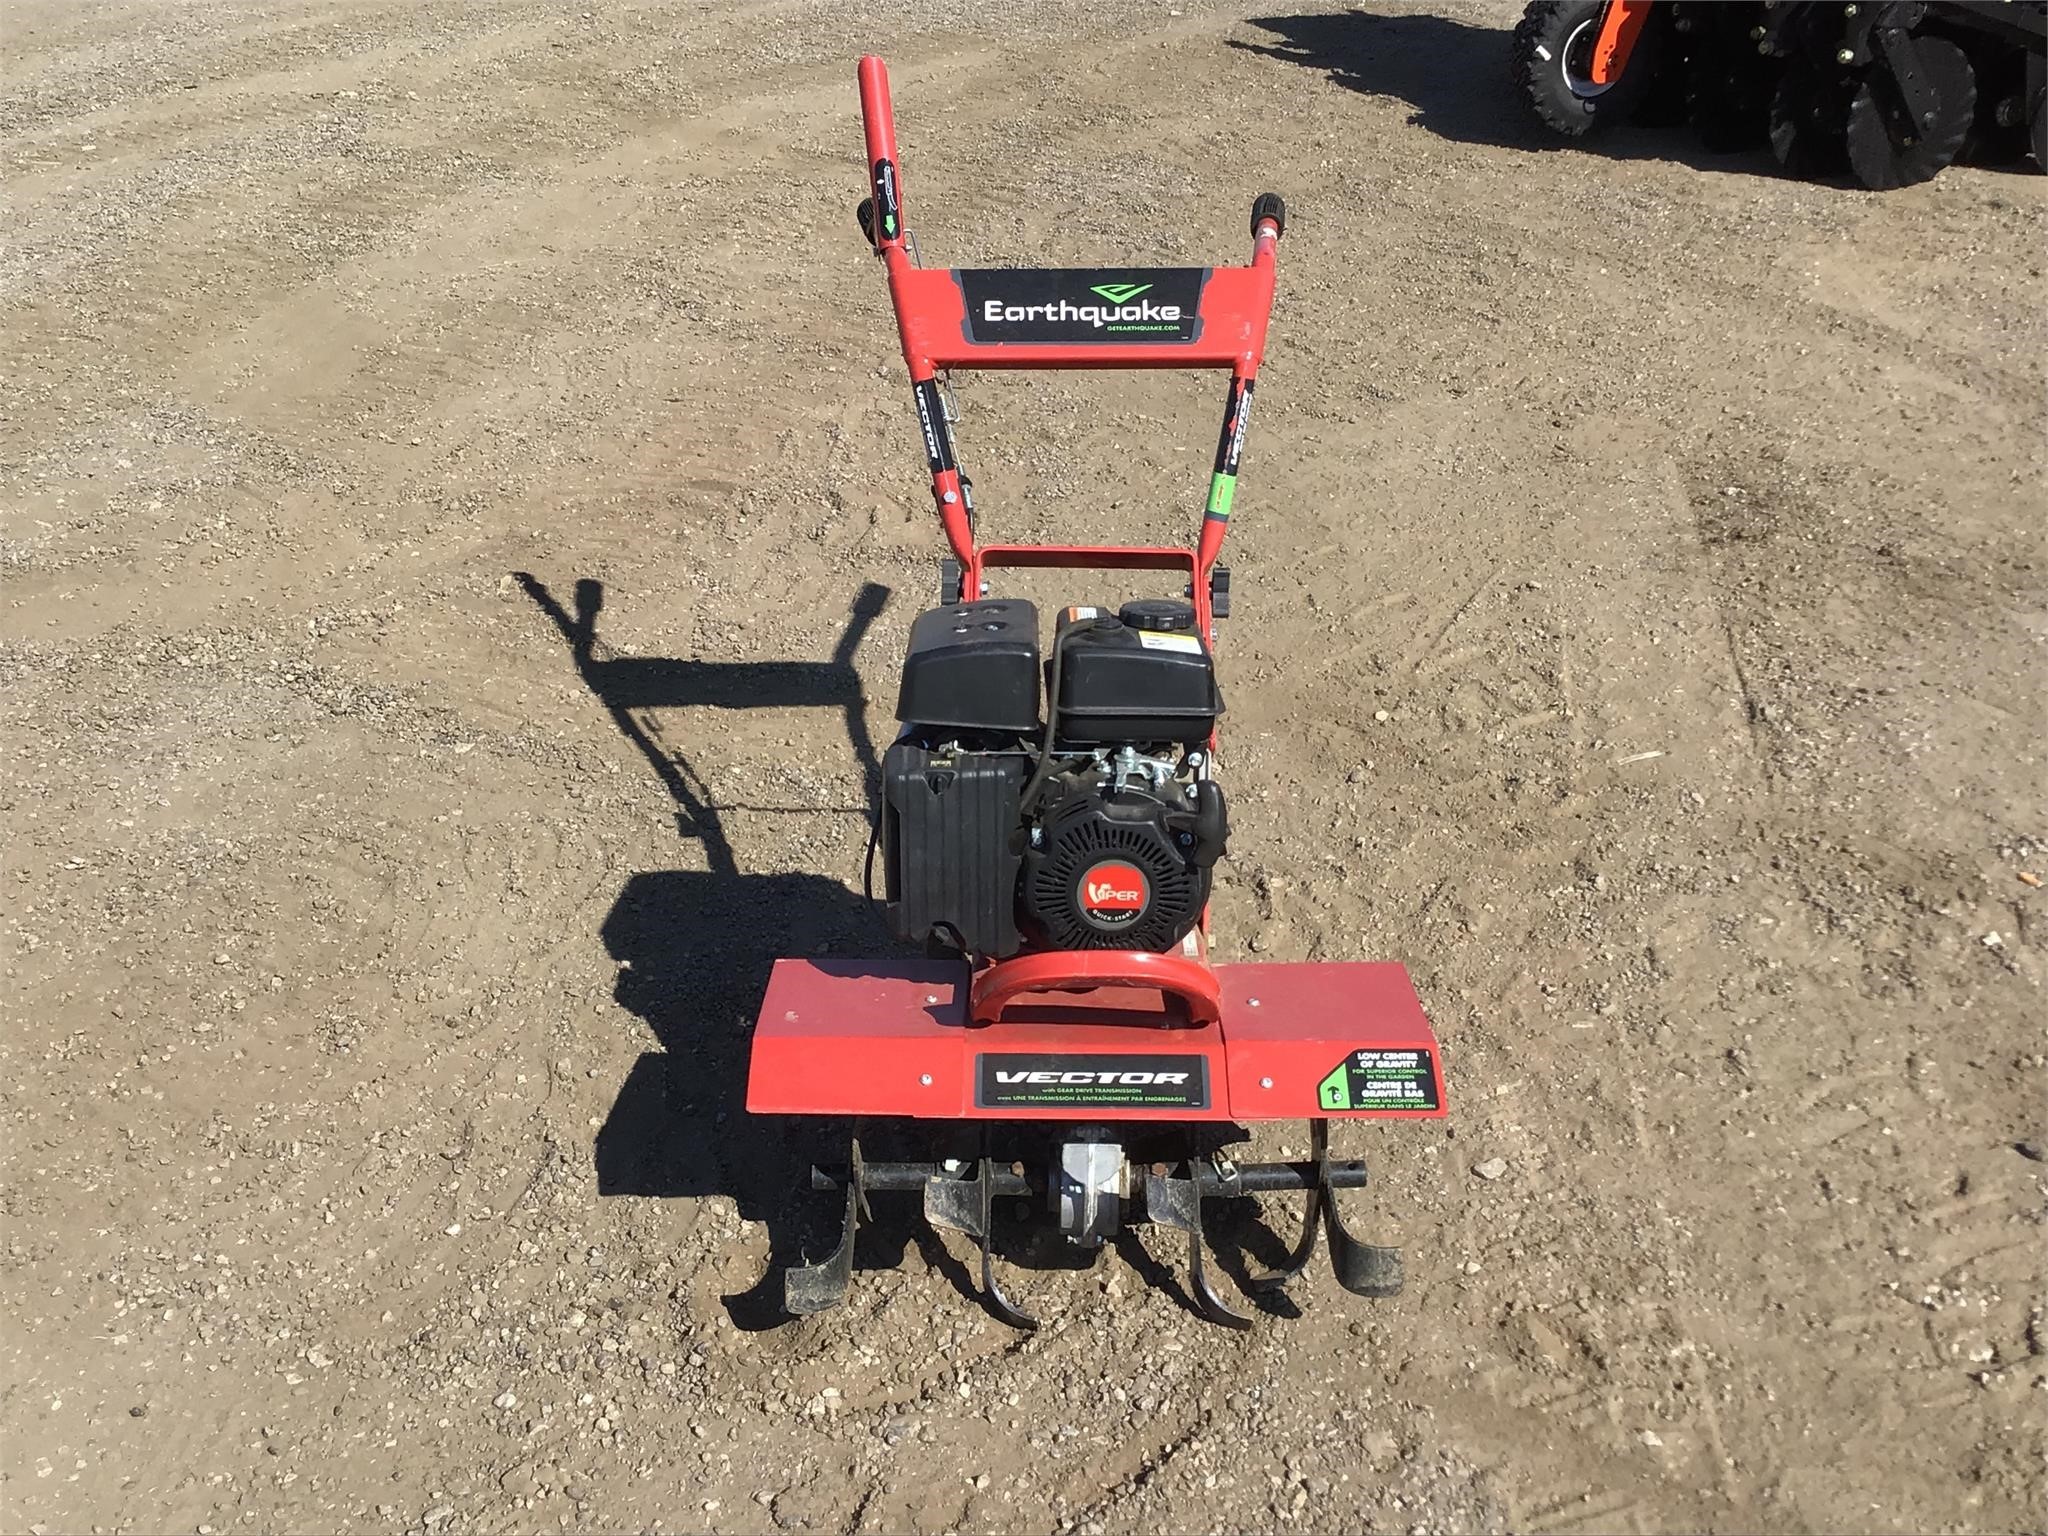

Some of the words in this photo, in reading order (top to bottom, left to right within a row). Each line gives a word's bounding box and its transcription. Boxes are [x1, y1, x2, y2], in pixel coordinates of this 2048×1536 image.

[984, 299, 1181, 328] Earthquake
[916, 384, 939, 459] VECTOR
[1092, 909, 1134, 921] QUICK-START
[1357, 1052, 1381, 1060] LOW
[1382, 1052, 1418, 1060] CENTER
[996, 1071, 1189, 1085] VECTOR
[1366, 1081, 1402, 1090] CENTRE
[1404, 1081, 1418, 1090] DE
[1404, 1090, 1424, 1098] BAS
